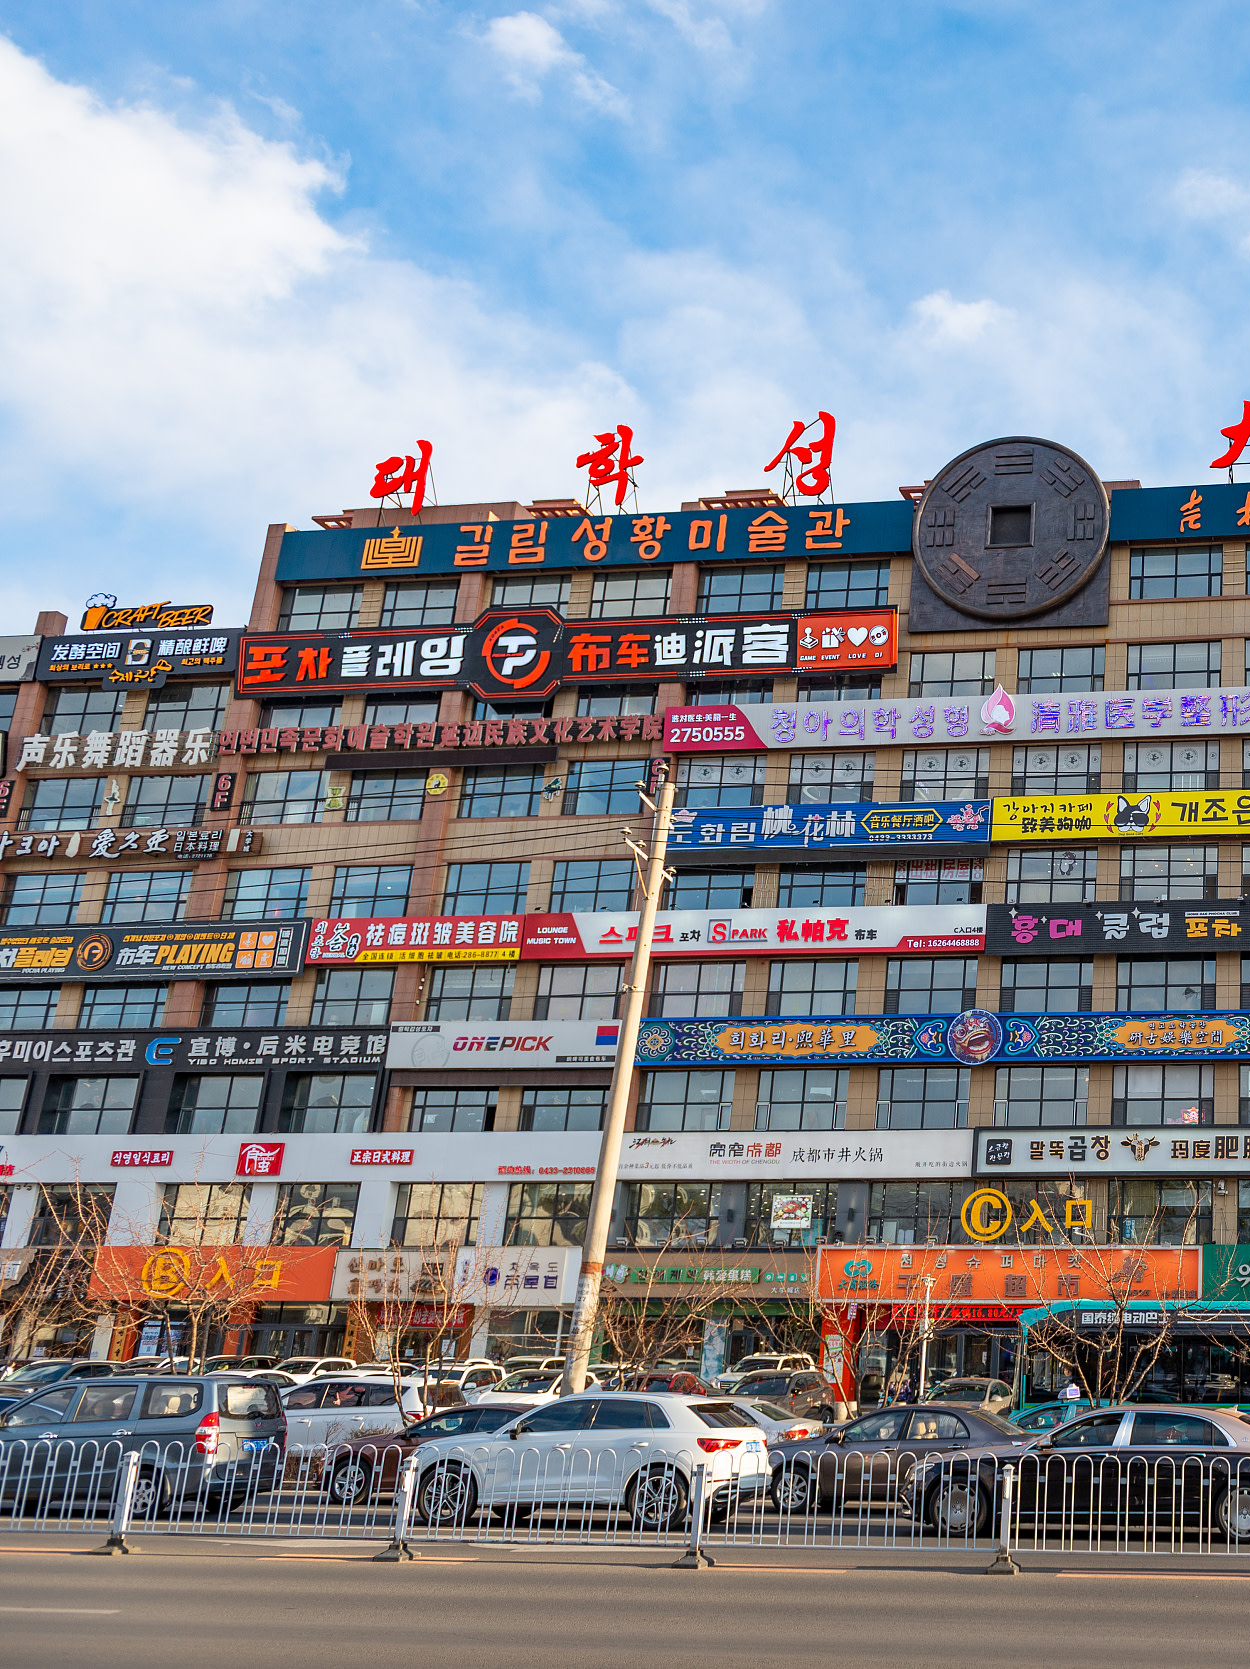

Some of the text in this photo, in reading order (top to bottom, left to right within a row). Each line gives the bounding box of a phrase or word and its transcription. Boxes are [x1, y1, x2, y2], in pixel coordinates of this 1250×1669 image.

[102, 601, 212, 628] CRAFT BEER
[51, 643, 121, 661] 发酵空间
[157, 638, 228, 656] 精酿鲜啤
[567, 624, 790, 672] 布车迪派客
[243, 635, 467, 685] 포차 플레잉
[772, 705, 970, 743] 청아의학성형
[670, 726, 745, 743] 2750555
[15, 727, 212, 772] 声乐舞蹈器乐
[214, 774, 231, 808] 6F
[870, 814, 935, 829] 音乐餐厅酒吧
[176, 829, 223, 841] 일본료리
[174, 842, 220, 852] 日本料理
[366, 920, 519, 946] 祛痘斑皱美容院
[679, 929, 701, 942] 포차
[776, 917, 877, 942] 私帕克 布车
[1011, 913, 1242, 944] 홍대 클럽 포차
[907, 938, 980, 949] Tel: 16264468888
[154, 943, 236, 965] PLAYING
[453, 1035, 554, 1052] ONEPICK
[323, 1056, 381, 1064] STADIUM
[352, 1151, 411, 1164] 正宗日式料理
[789, 1147, 884, 1163] 成都市井火锅
[1030, 1136, 1111, 1161] 말뚝곱창
[1020, 1200, 1093, 1232] 入口
